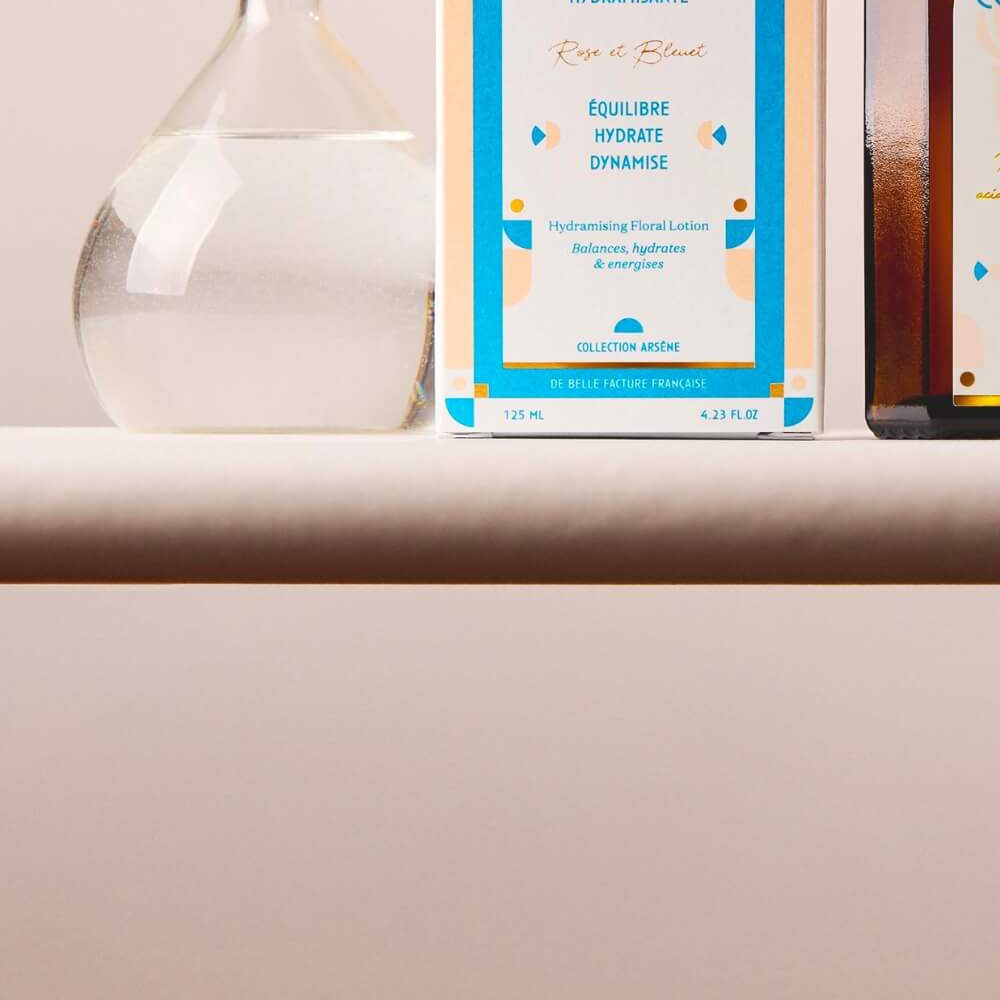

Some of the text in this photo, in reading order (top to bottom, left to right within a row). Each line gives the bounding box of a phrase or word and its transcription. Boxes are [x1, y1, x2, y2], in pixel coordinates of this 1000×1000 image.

[547, 39, 708, 69] Rose et Bleuet
[588, 99, 670, 117] ÉQUILIBRE
[594, 128, 664, 143] HYDRATE
[590, 155, 669, 170] DYNAMISE
[548, 220, 709, 235] Hydramising Floral Lotion
[571, 242, 687, 257] Balances, hydrates
[593, 259, 665, 273] & energises
[576, 341, 637, 353] COLLECTION
[550, 378, 708, 392] DE BELLE FACTURE FRANÇAISE
[504, 409, 545, 421] 125 ML
[700, 409, 727, 421] 4.23
